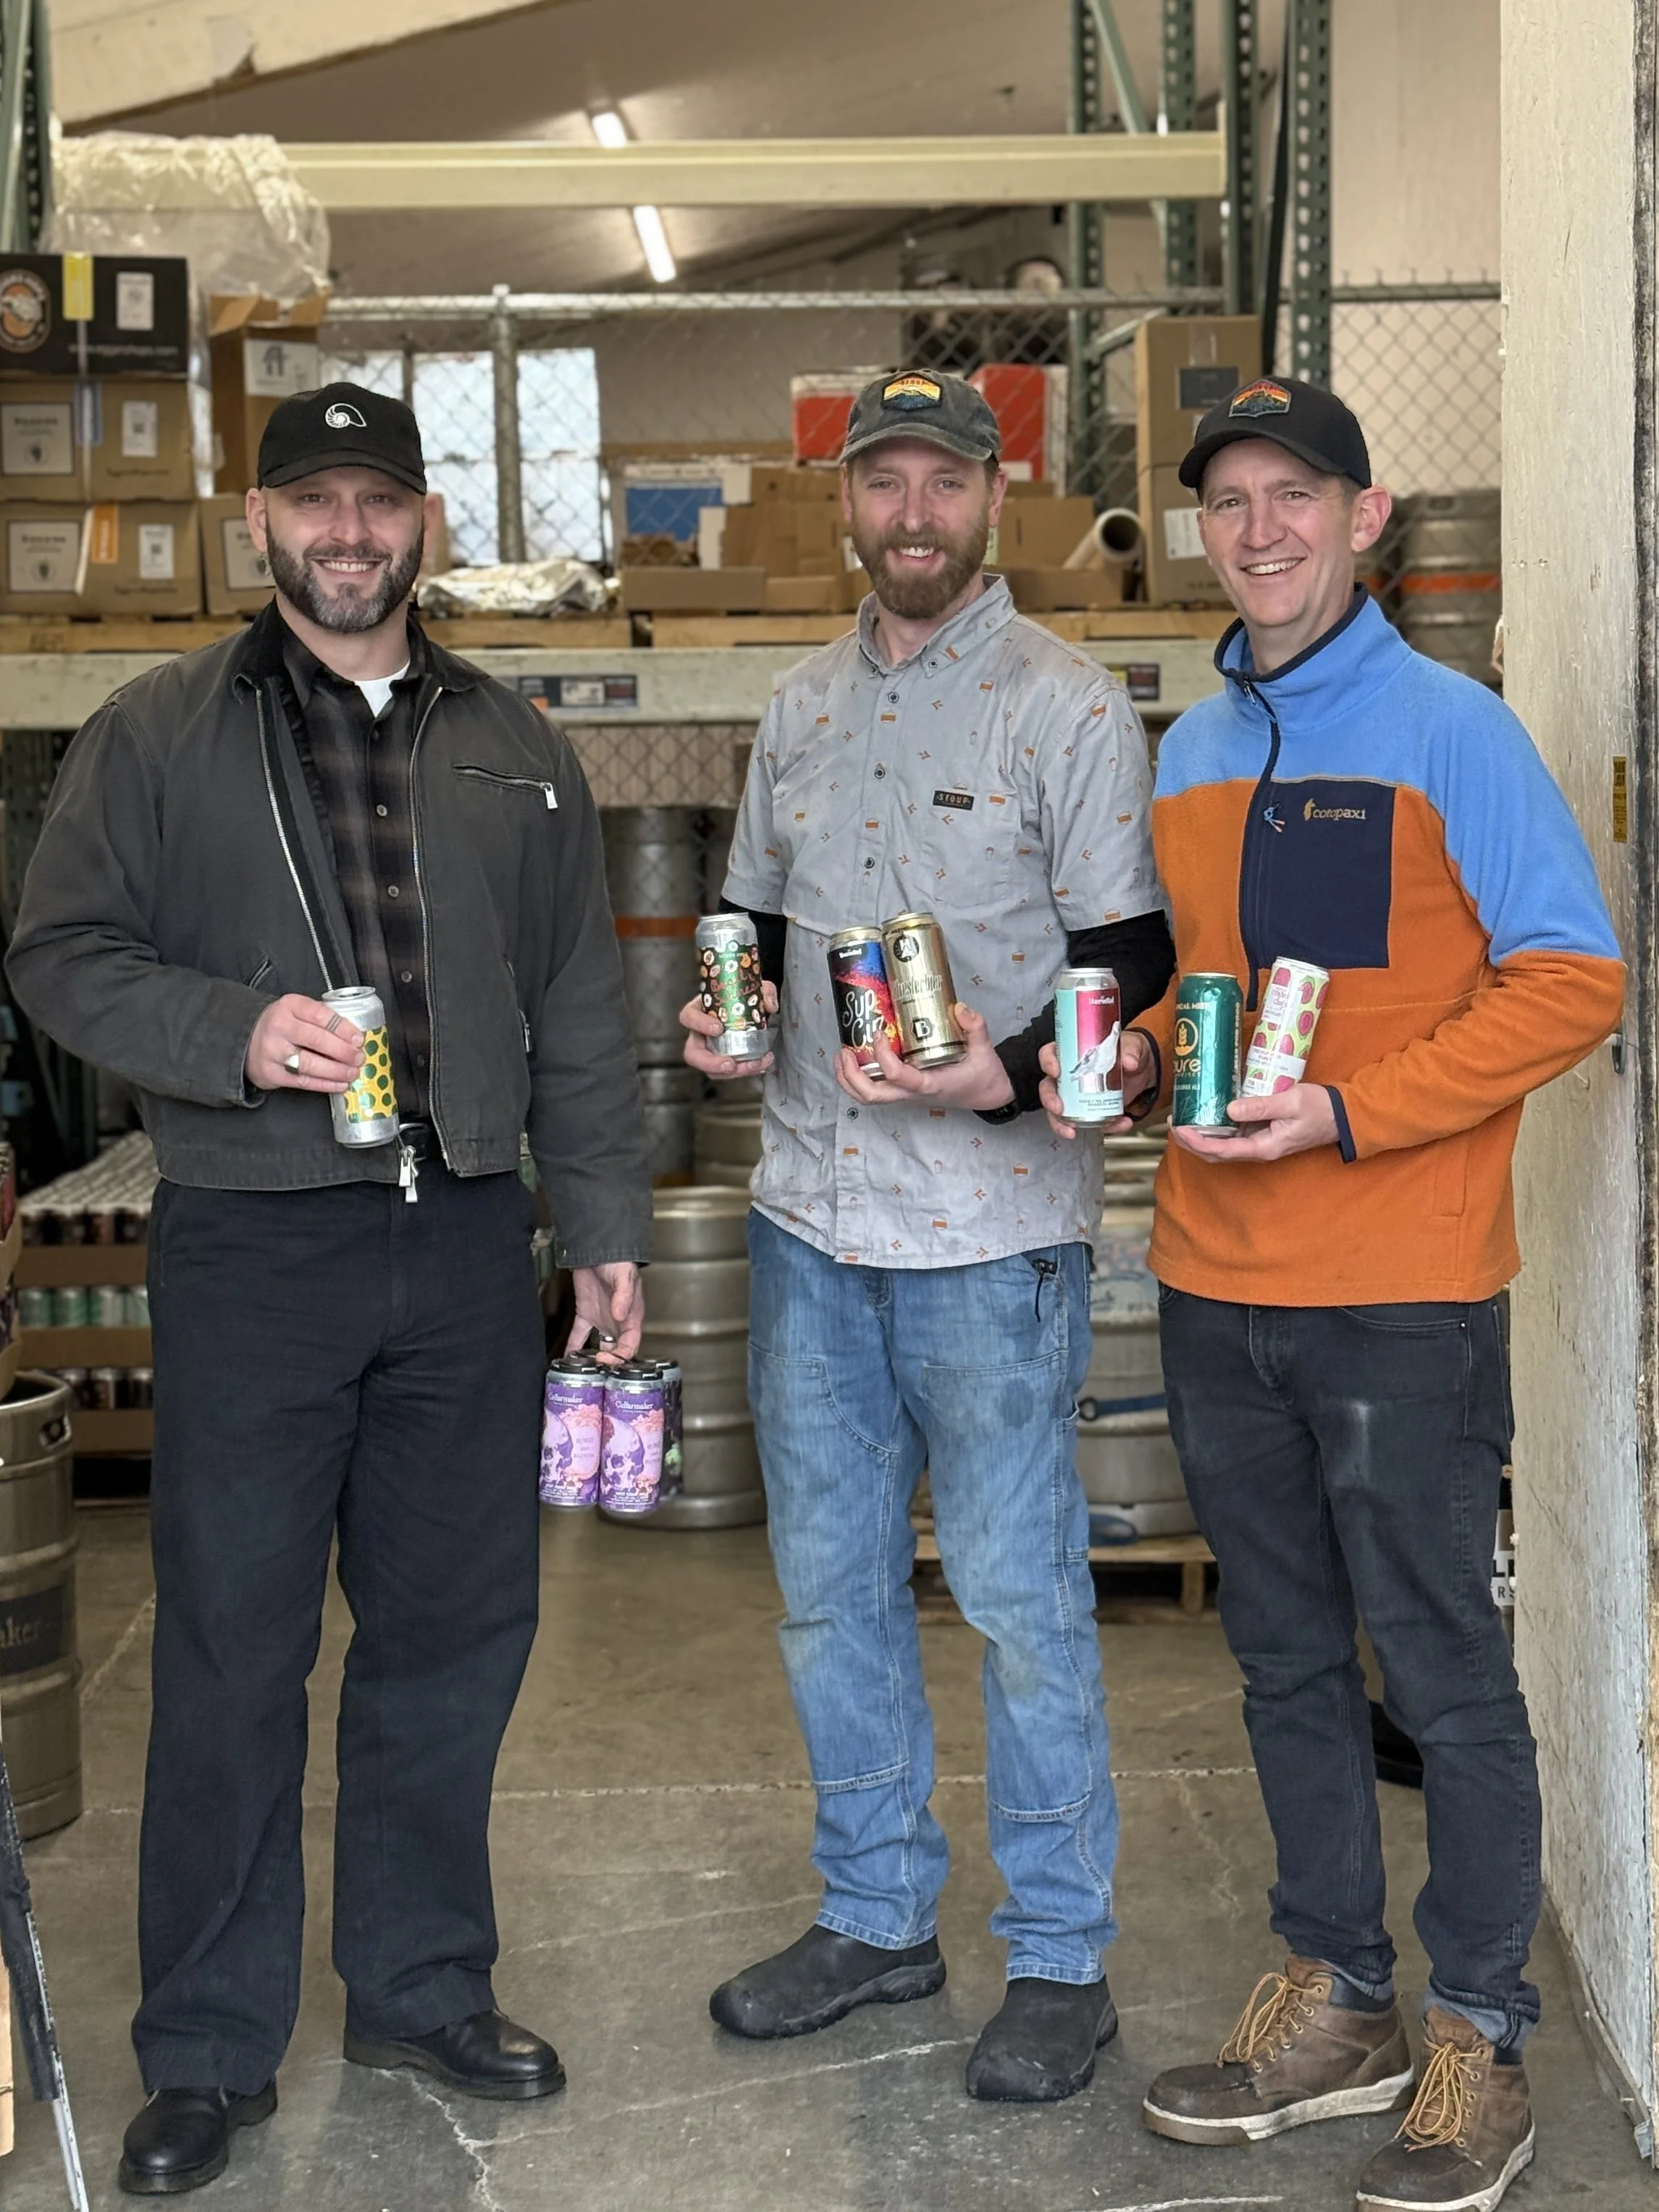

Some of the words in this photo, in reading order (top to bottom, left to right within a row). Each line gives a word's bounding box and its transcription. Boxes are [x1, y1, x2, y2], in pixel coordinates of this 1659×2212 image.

[937, 792, 968, 804] STOUP
[1312, 808, 1366, 821] cotopaxi
[615, 1400, 654, 1410] Cellarmaker
